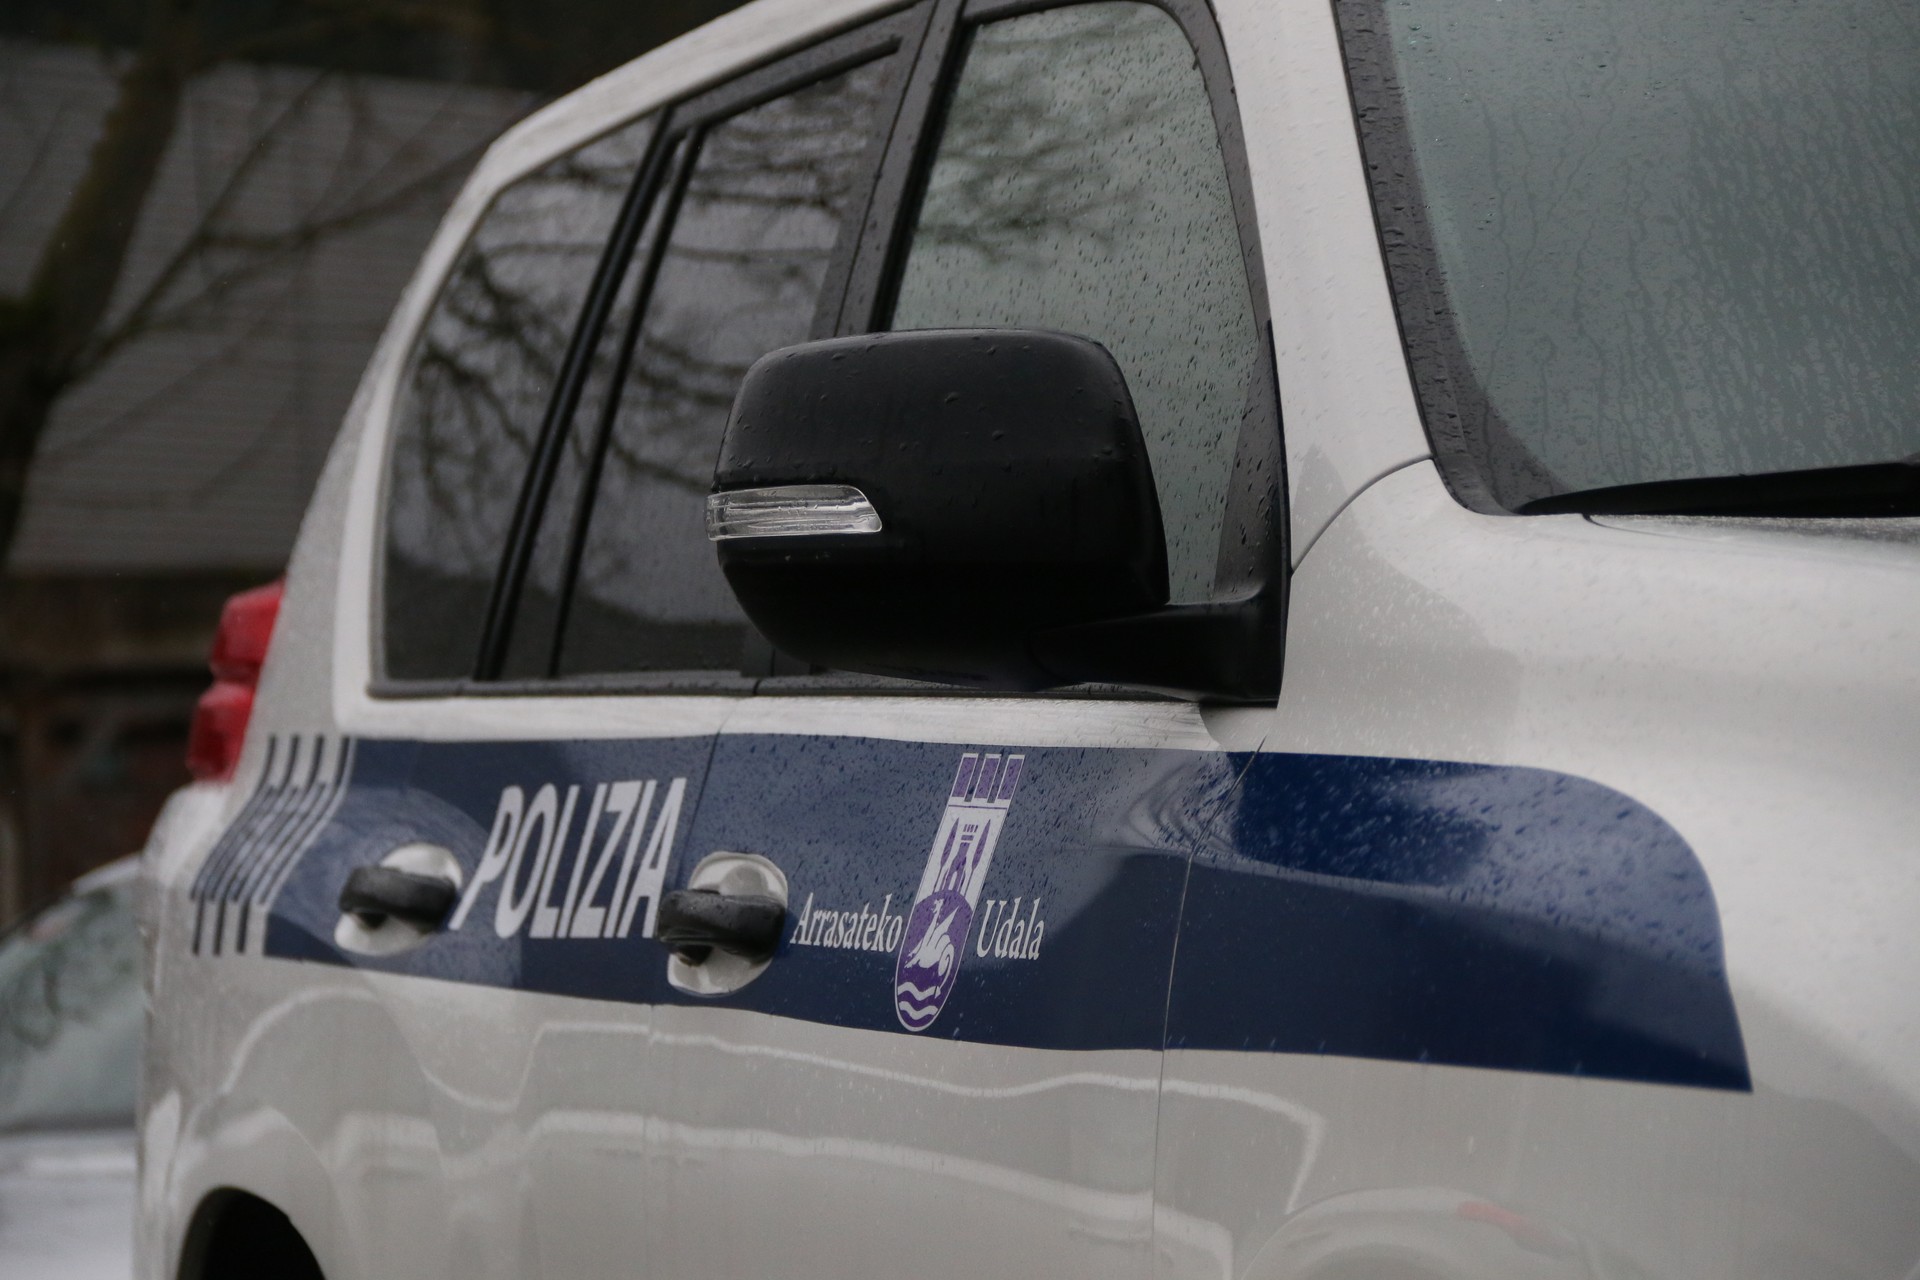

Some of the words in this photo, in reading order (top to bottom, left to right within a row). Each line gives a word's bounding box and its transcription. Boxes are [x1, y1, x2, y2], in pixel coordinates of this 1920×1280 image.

[448, 777, 687, 938] POLIZIA
[789, 892, 903, 952] Arrasateko
[976, 896, 1045, 961] Udala
